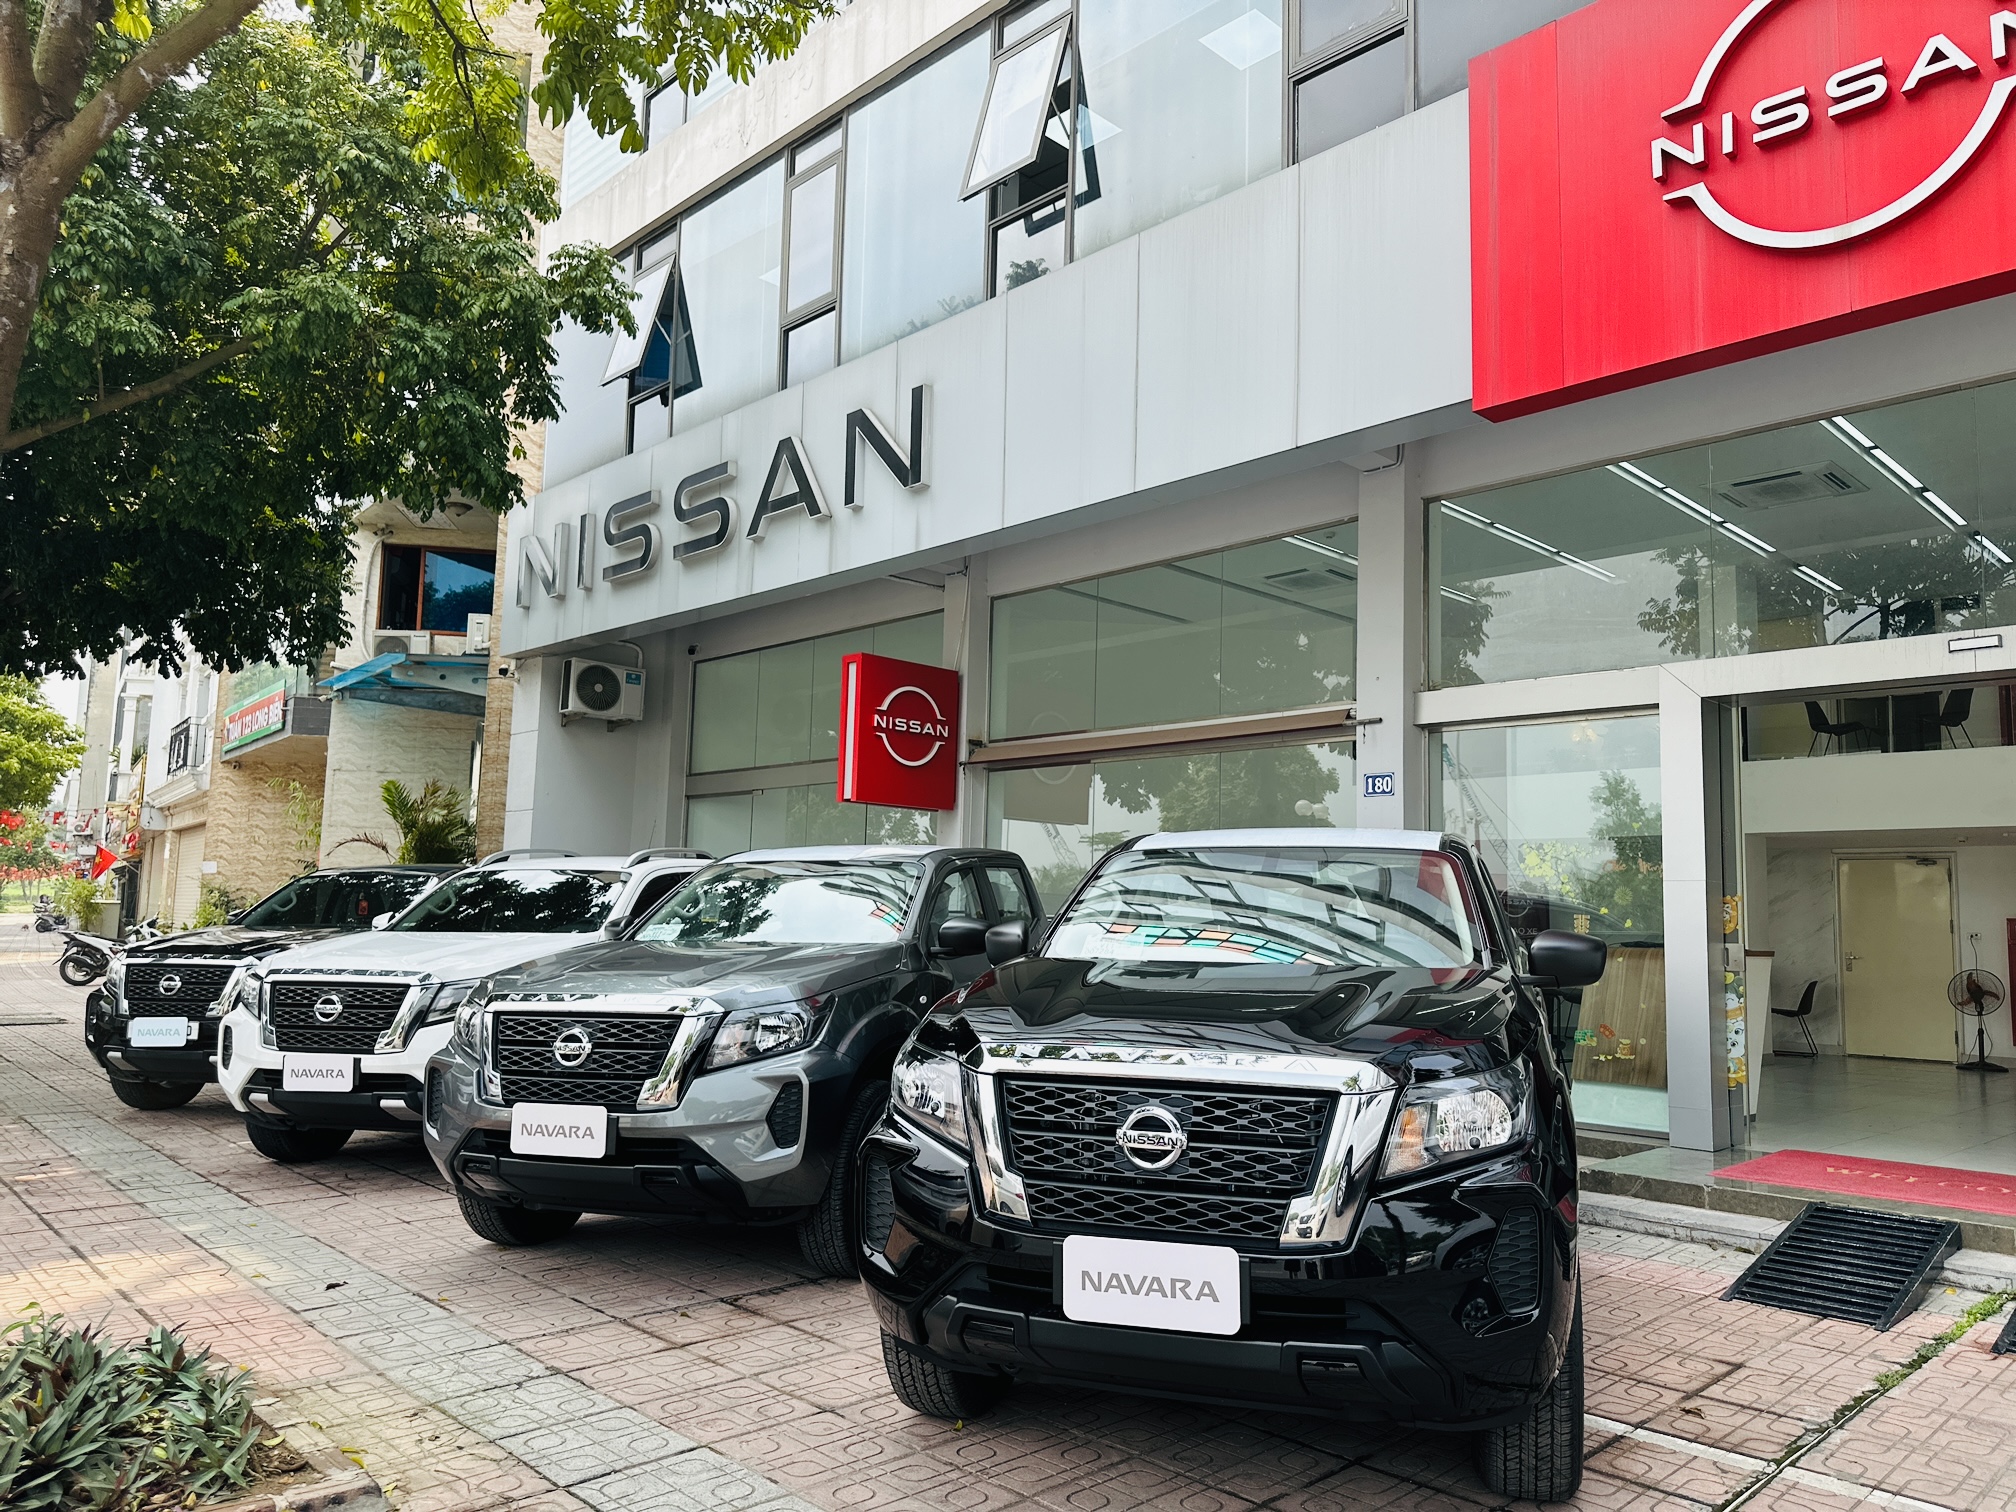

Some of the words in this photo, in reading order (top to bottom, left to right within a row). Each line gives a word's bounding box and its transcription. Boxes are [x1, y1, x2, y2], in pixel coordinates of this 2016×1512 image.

[516, 383, 933, 609] NISSAN
[252, 706, 268, 733] LONG
[873, 714, 949, 738] NISSAN
[1367, 776, 1392, 793] 180
[137, 1028, 181, 1037] NAVARA
[554, 1044, 586, 1052] NISSAN
[290, 1068, 345, 1079] NAVARA
[520, 1123, 596, 1140] NAVARA
[1121, 1133, 1180, 1148] NISSAN
[1080, 1270, 1221, 1304] NAVARA
